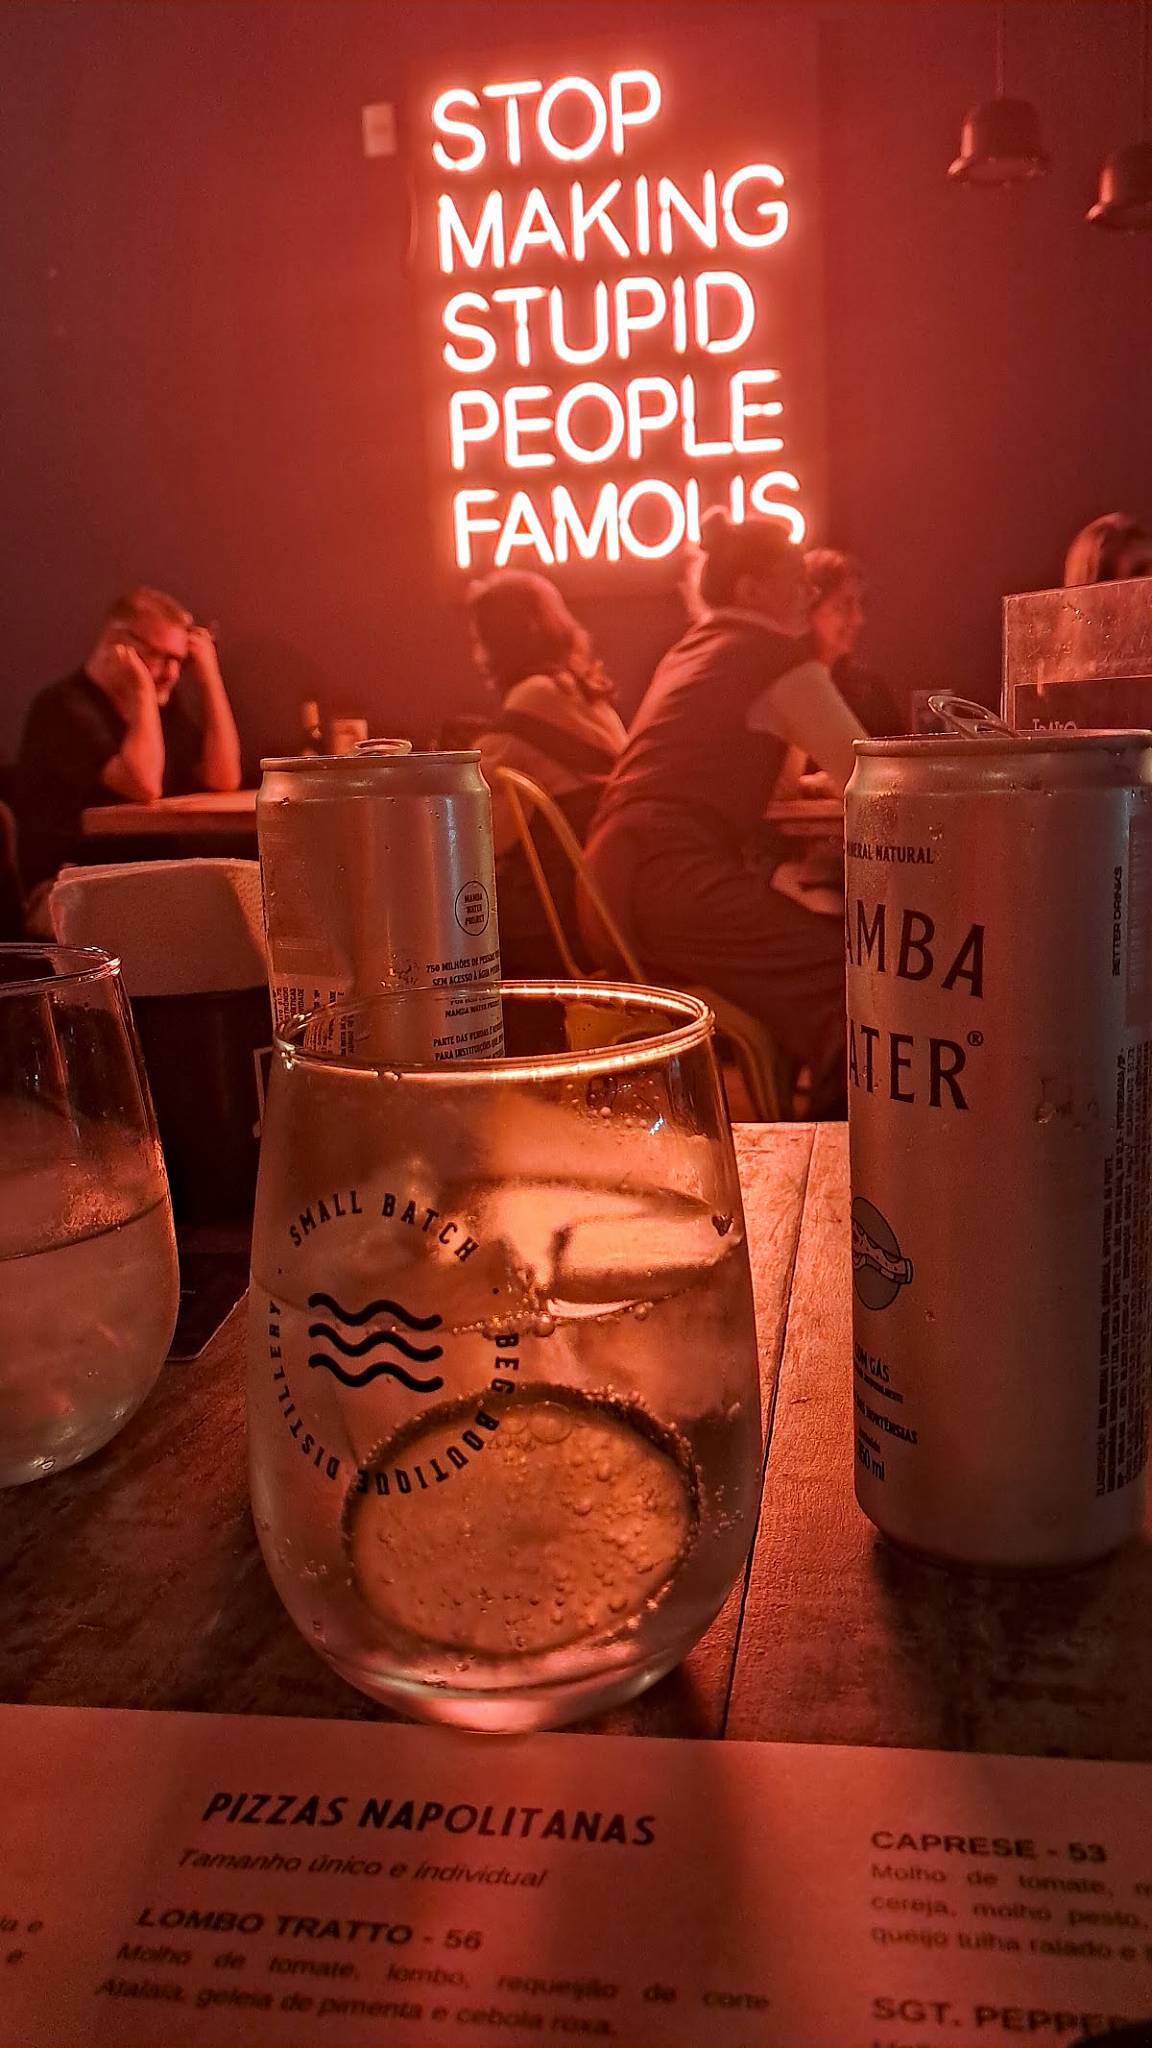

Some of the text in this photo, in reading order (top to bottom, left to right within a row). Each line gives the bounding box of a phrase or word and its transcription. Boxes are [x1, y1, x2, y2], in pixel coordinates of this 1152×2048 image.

[432, 69, 662, 172] STOP
[438, 164, 789, 273] MAKING
[443, 271, 755, 373] STUPID
[449, 369, 784, 470] PEOPLE
[876, 845, 934, 864] NATURAL
[289, 1190, 479, 1262] SMALL BATCH
[269, 1300, 519, 1496] BEG BOUTIQUE DISTILLERY
[202, 1793, 657, 1845] PIZZAS NAPOLITANAS
[178, 1848, 548, 1889] Tamanho único e individual
[871, 1830, 1038, 1861] CAPRESE
[871, 1863, 947, 1884] Molho
[966, 1869, 998, 1887] de
[137, 1908, 264, 1934] LOMBO
[277, 1915, 413, 1945] TRATTO
[443, 1929, 484, 1950] 56
[971, 1902, 1052, 1923] molho
[116, 1943, 192, 1966] Molho
[213, 1952, 246, 1970] de
[642, 1980, 677, 2004] de
[280, 1992, 312, 2013] de
[316, 1997, 423, 2020] pimenta
[431, 2006, 448, 2022] e
[872, 1997, 961, 2027] SGT.
